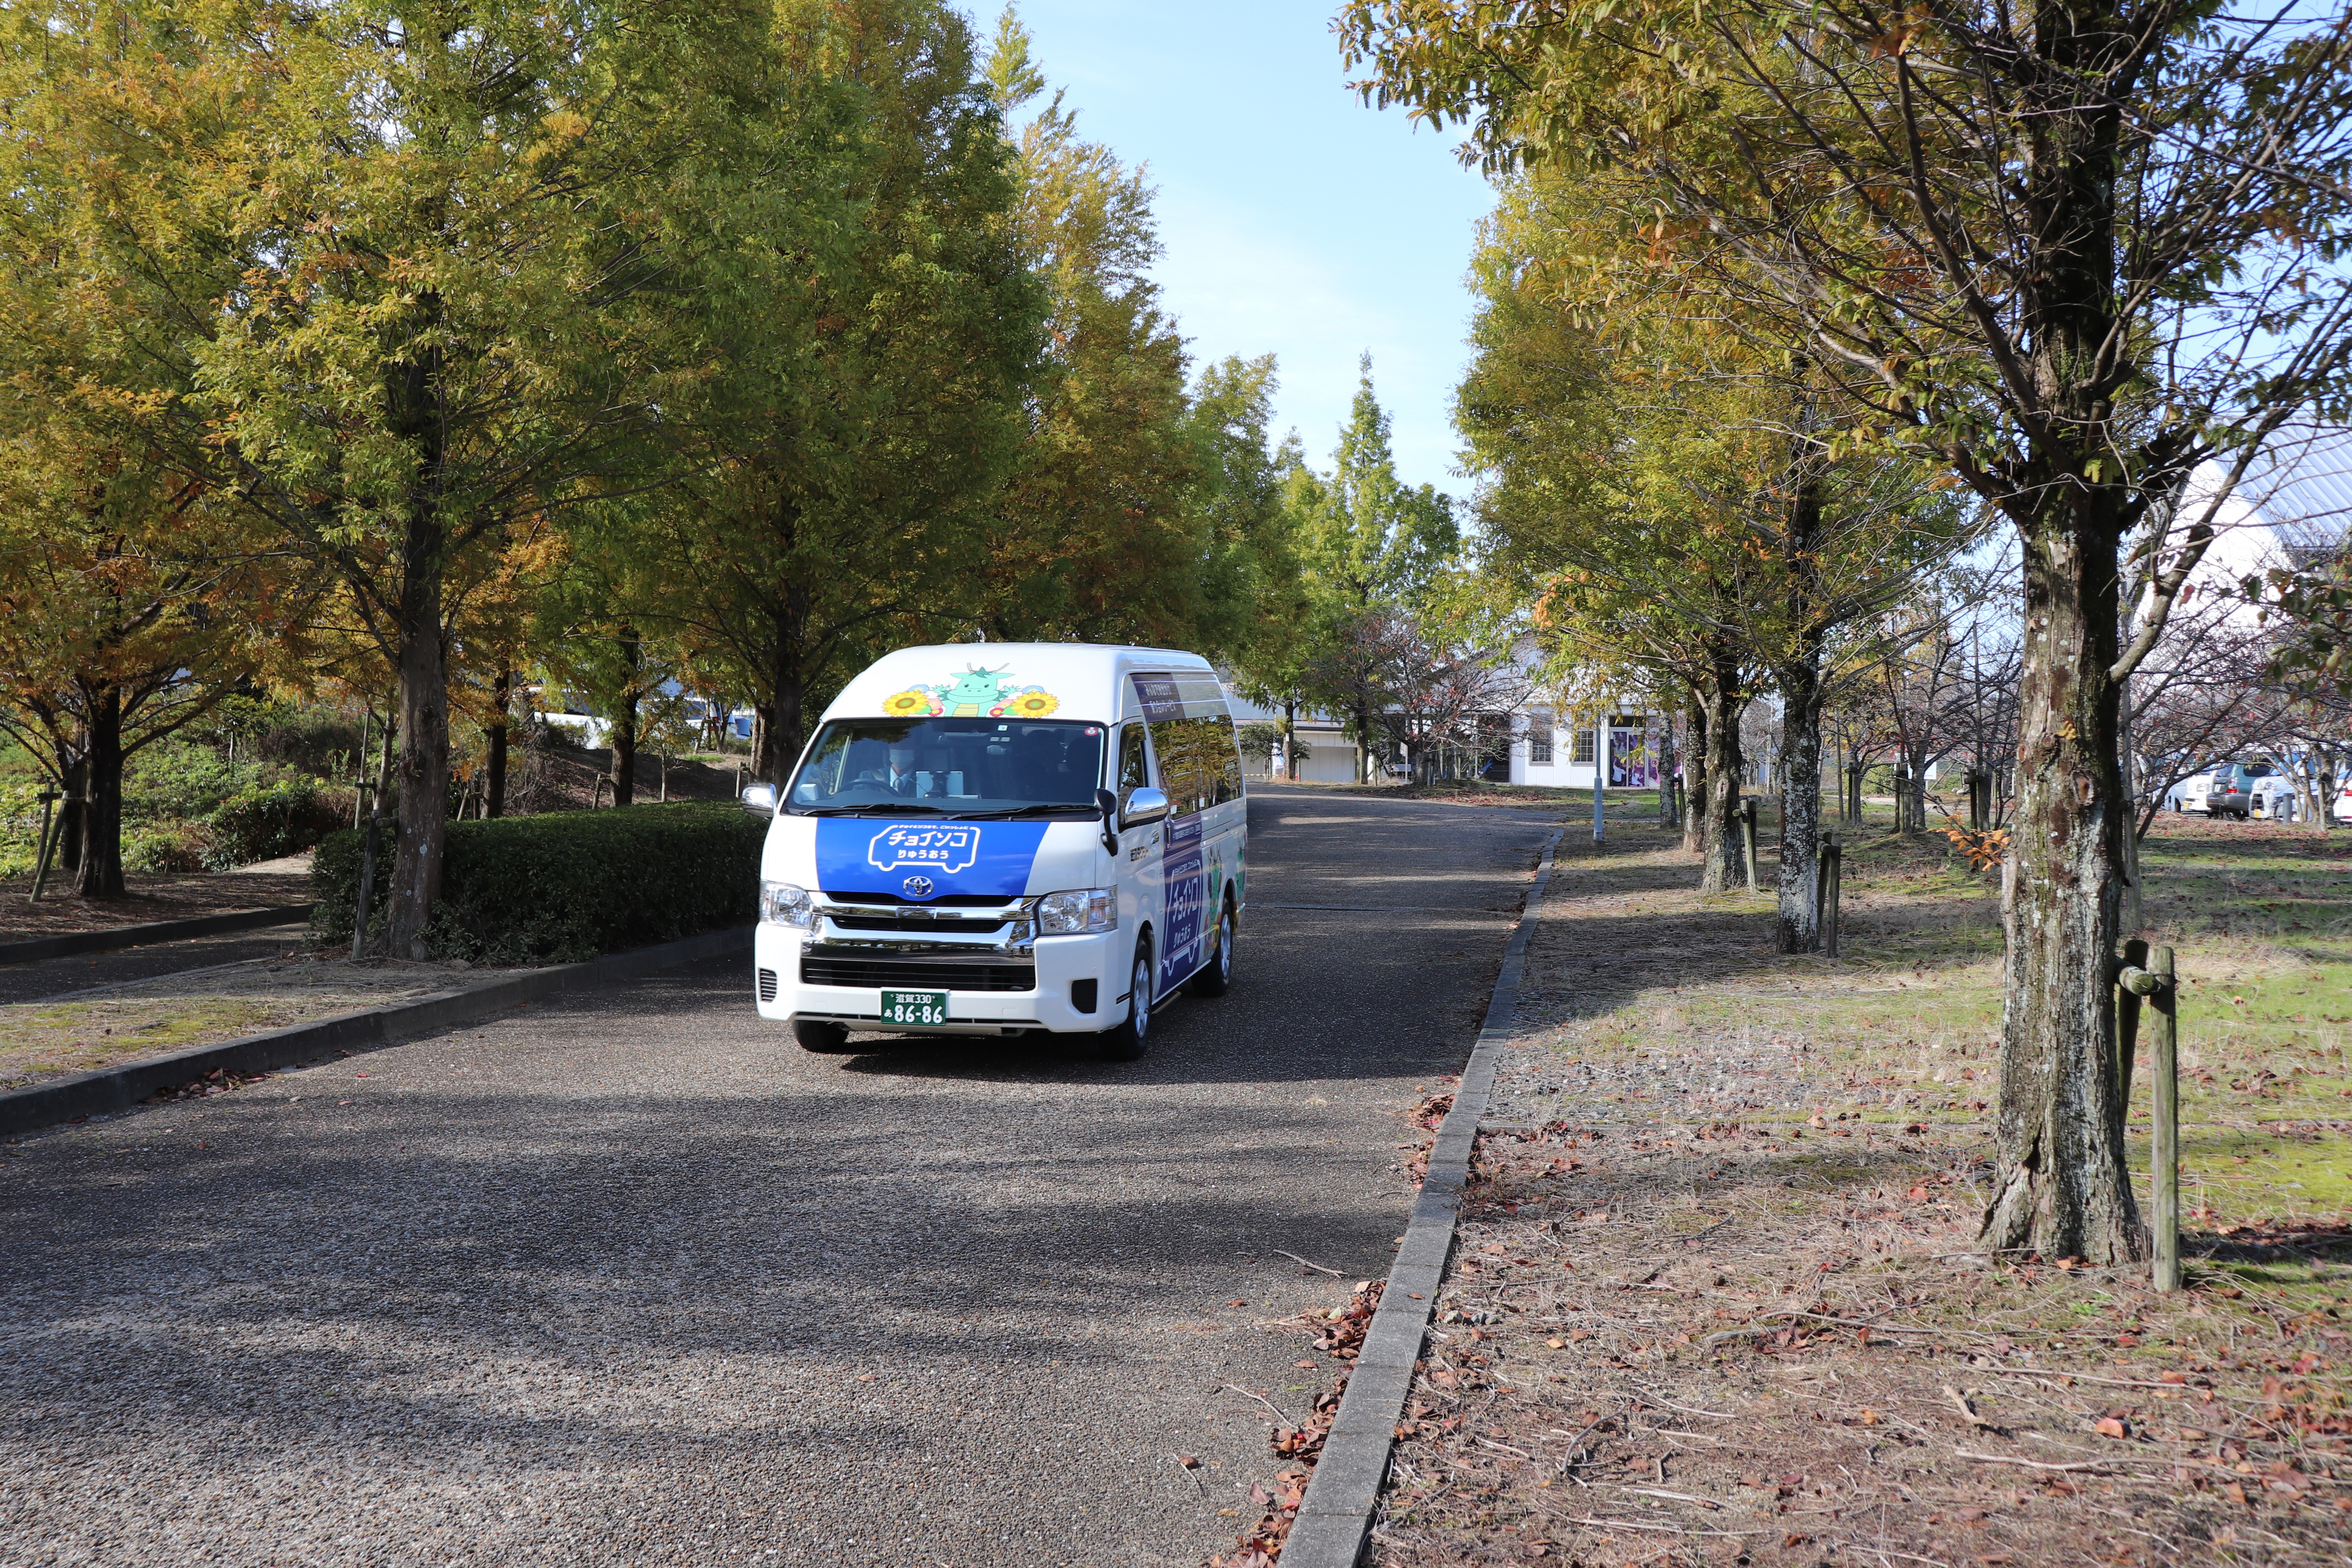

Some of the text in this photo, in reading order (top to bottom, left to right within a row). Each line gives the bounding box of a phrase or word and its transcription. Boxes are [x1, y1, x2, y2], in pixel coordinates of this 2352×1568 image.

[888, 830, 968, 847] チョイソコ
[897, 849, 949, 859] りゅうおう
[1172, 877, 1198, 923] チョイソコ
[884, 1005, 943, 1024] あ 86-86
